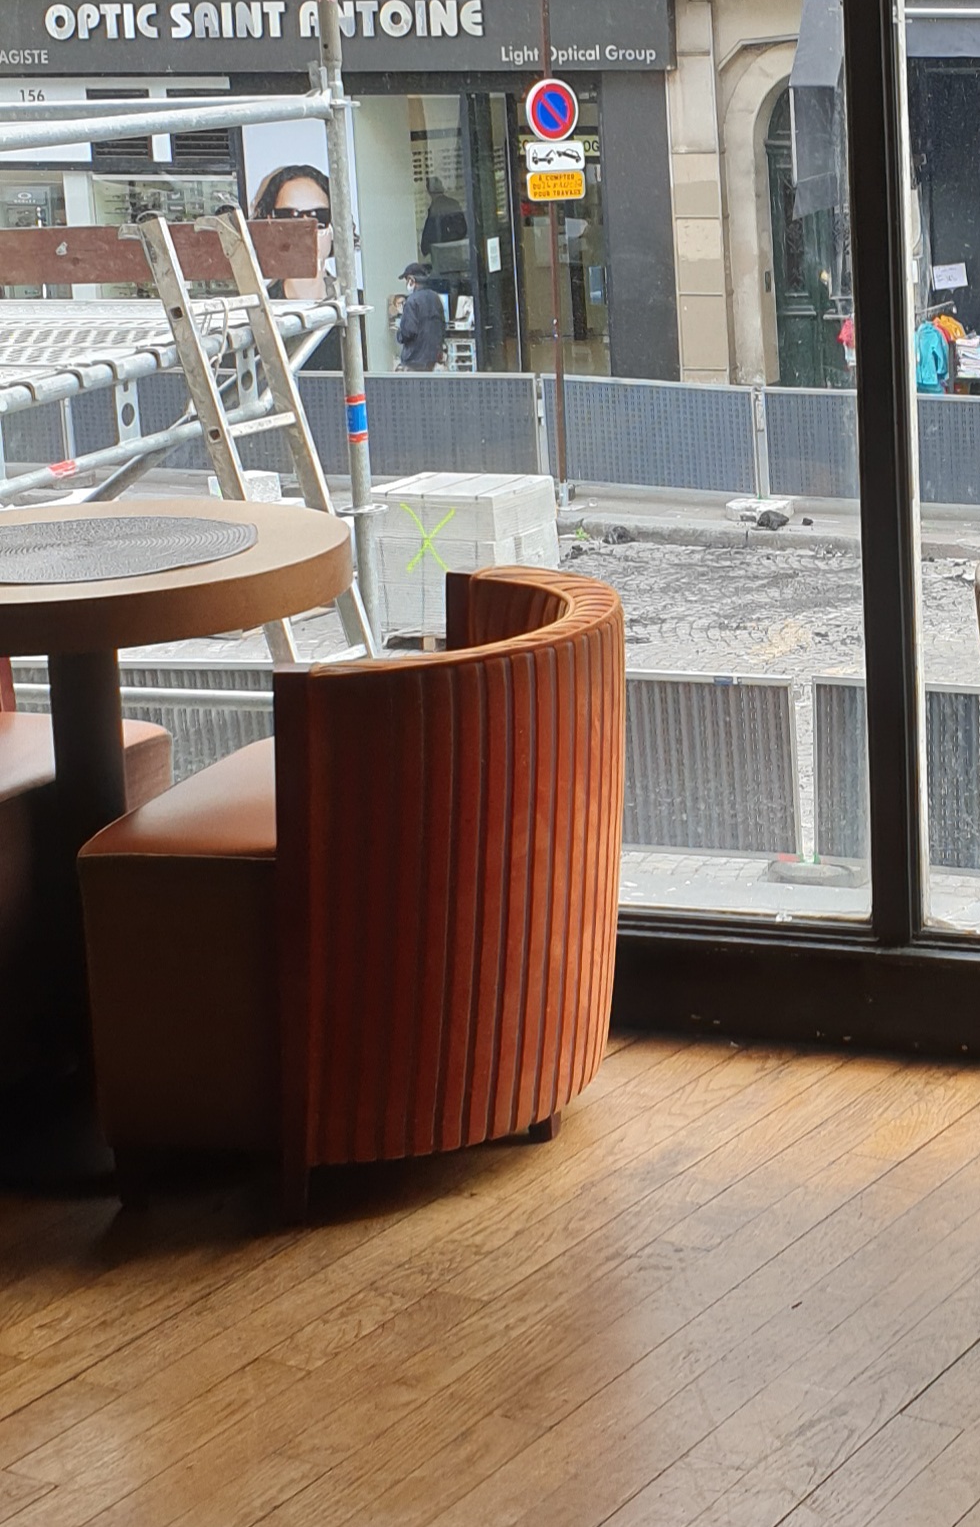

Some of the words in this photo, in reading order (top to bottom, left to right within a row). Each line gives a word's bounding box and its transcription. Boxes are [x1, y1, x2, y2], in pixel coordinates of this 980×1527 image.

[44, 0, 159, 41] OPTIC
[171, 0, 286, 39] SAINT
[501, 45, 540, 65] Light
[605, 45, 656, 64] Group
[19, 88, 45, 102] 156
